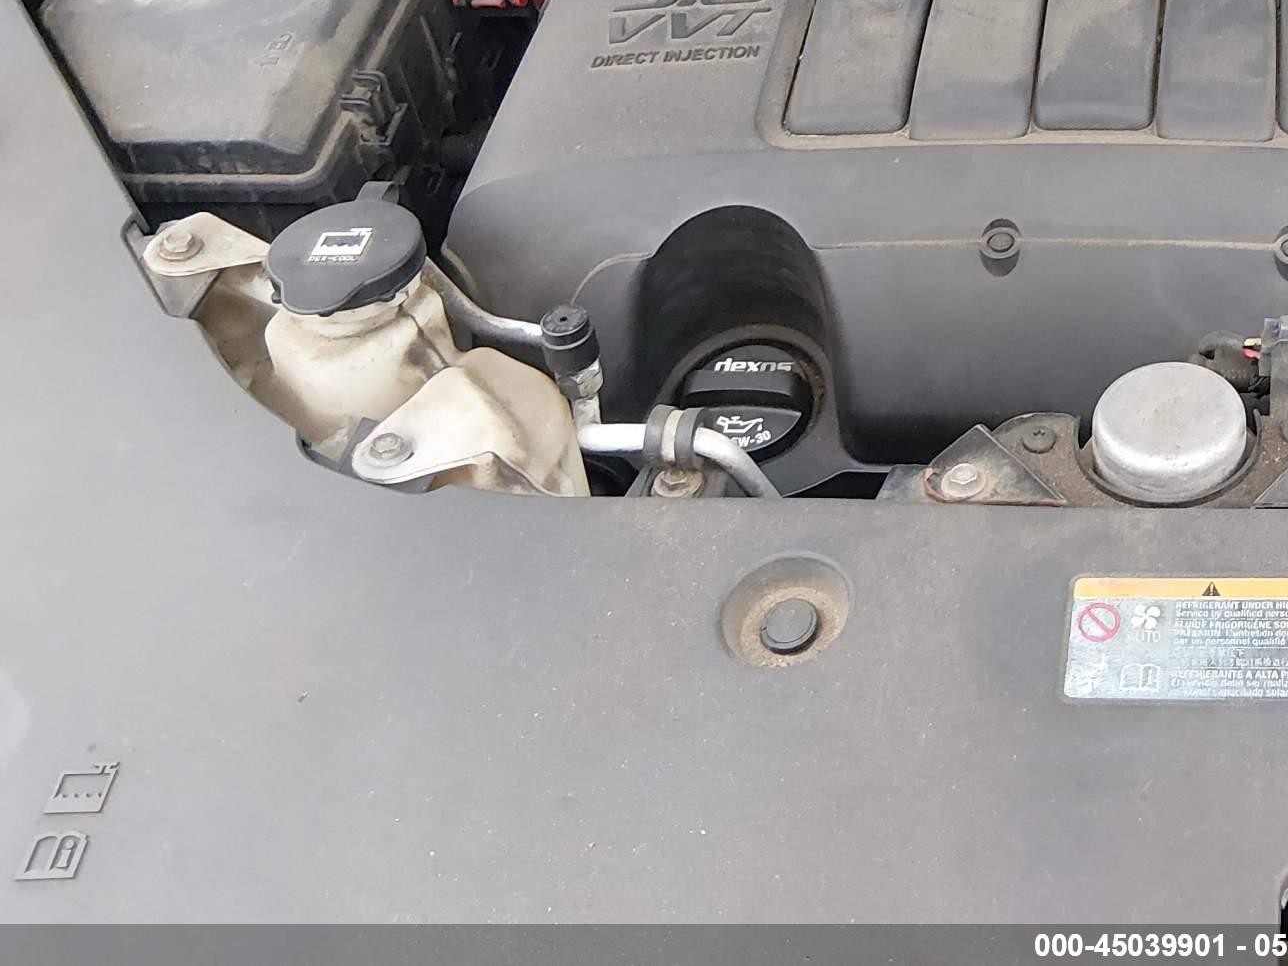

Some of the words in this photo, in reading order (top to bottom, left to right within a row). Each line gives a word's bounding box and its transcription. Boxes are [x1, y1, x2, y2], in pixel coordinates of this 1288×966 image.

[609, 7, 772, 44] VVT
[590, 50, 660, 68] DIRECT
[663, 45, 760, 63] INJECTION
[1175, 601, 1240, 609] REFRIGERANT
[1241, 601, 1273, 609] UNDER
[1211, 610, 1222, 618] by
[1224, 610, 1263, 618] qualified
[1245, 670, 1253, 679] A
[1255, 670, 1279, 679] ALTA
